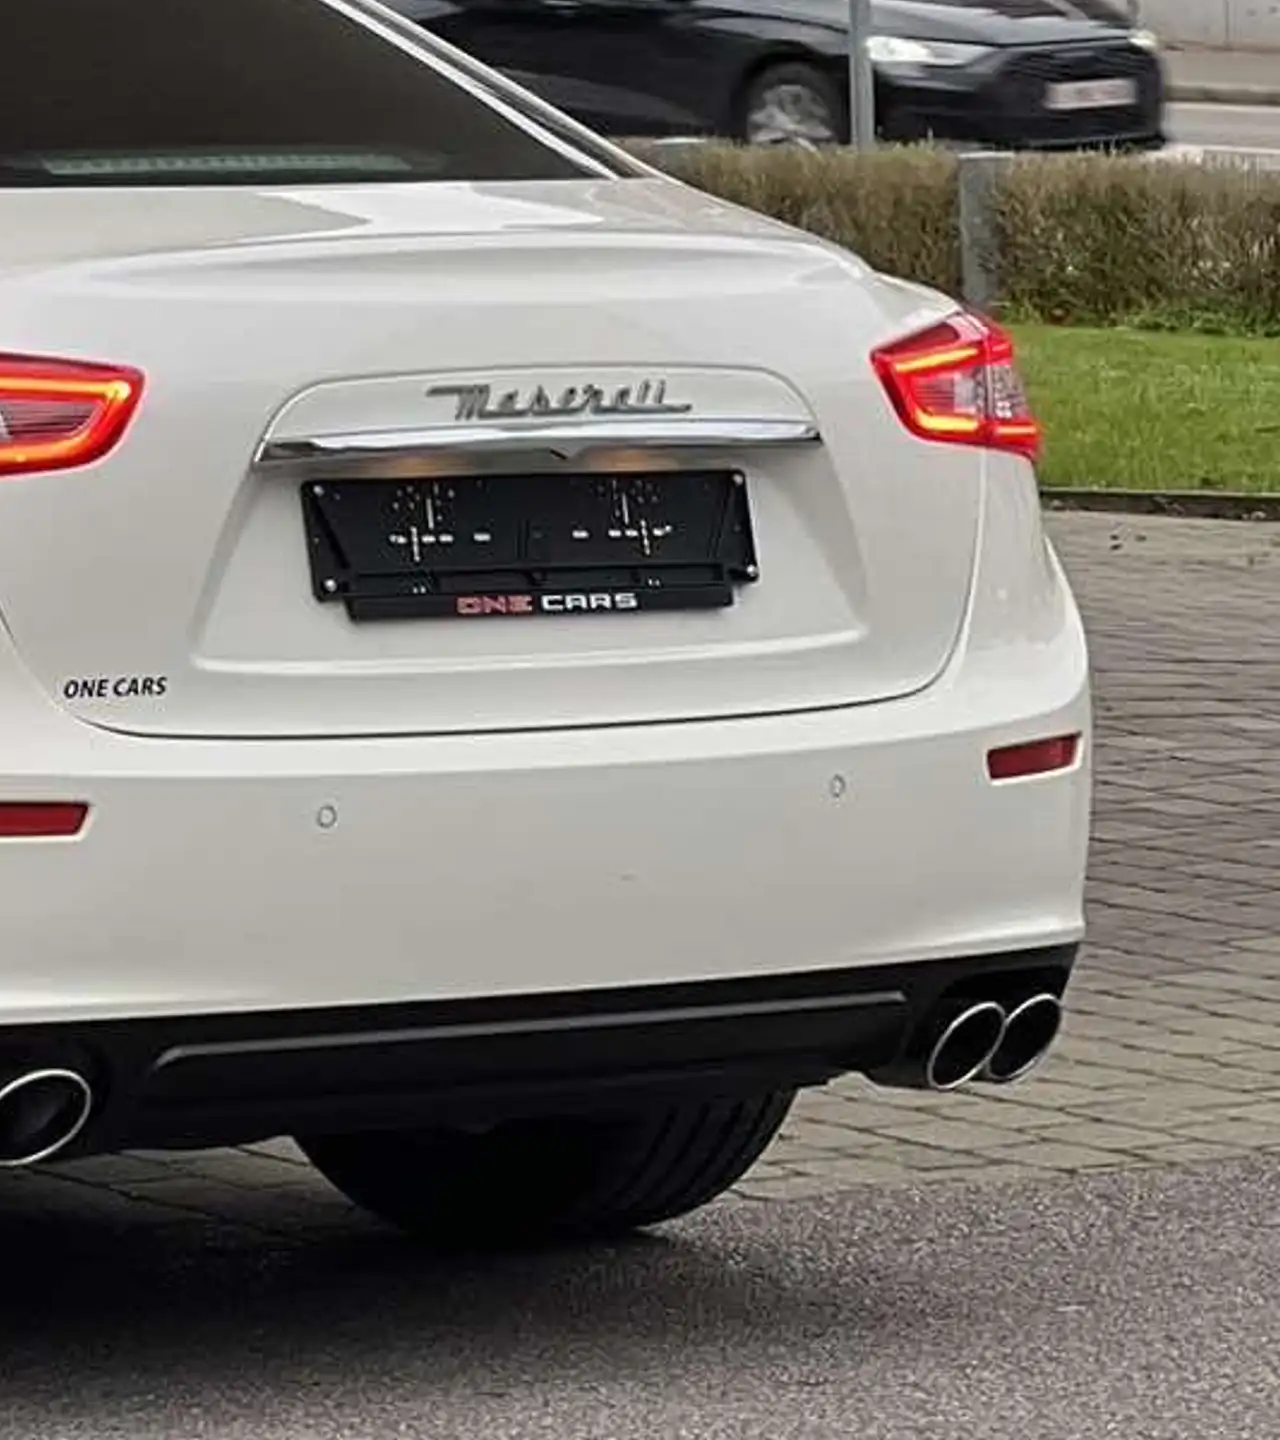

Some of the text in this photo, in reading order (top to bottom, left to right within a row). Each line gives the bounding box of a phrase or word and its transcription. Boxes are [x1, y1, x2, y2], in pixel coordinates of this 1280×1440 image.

[424, 378, 694, 422] Maserati
[456, 592, 639, 615] ONE CARS
[63, 676, 168, 699] ONE CARS
